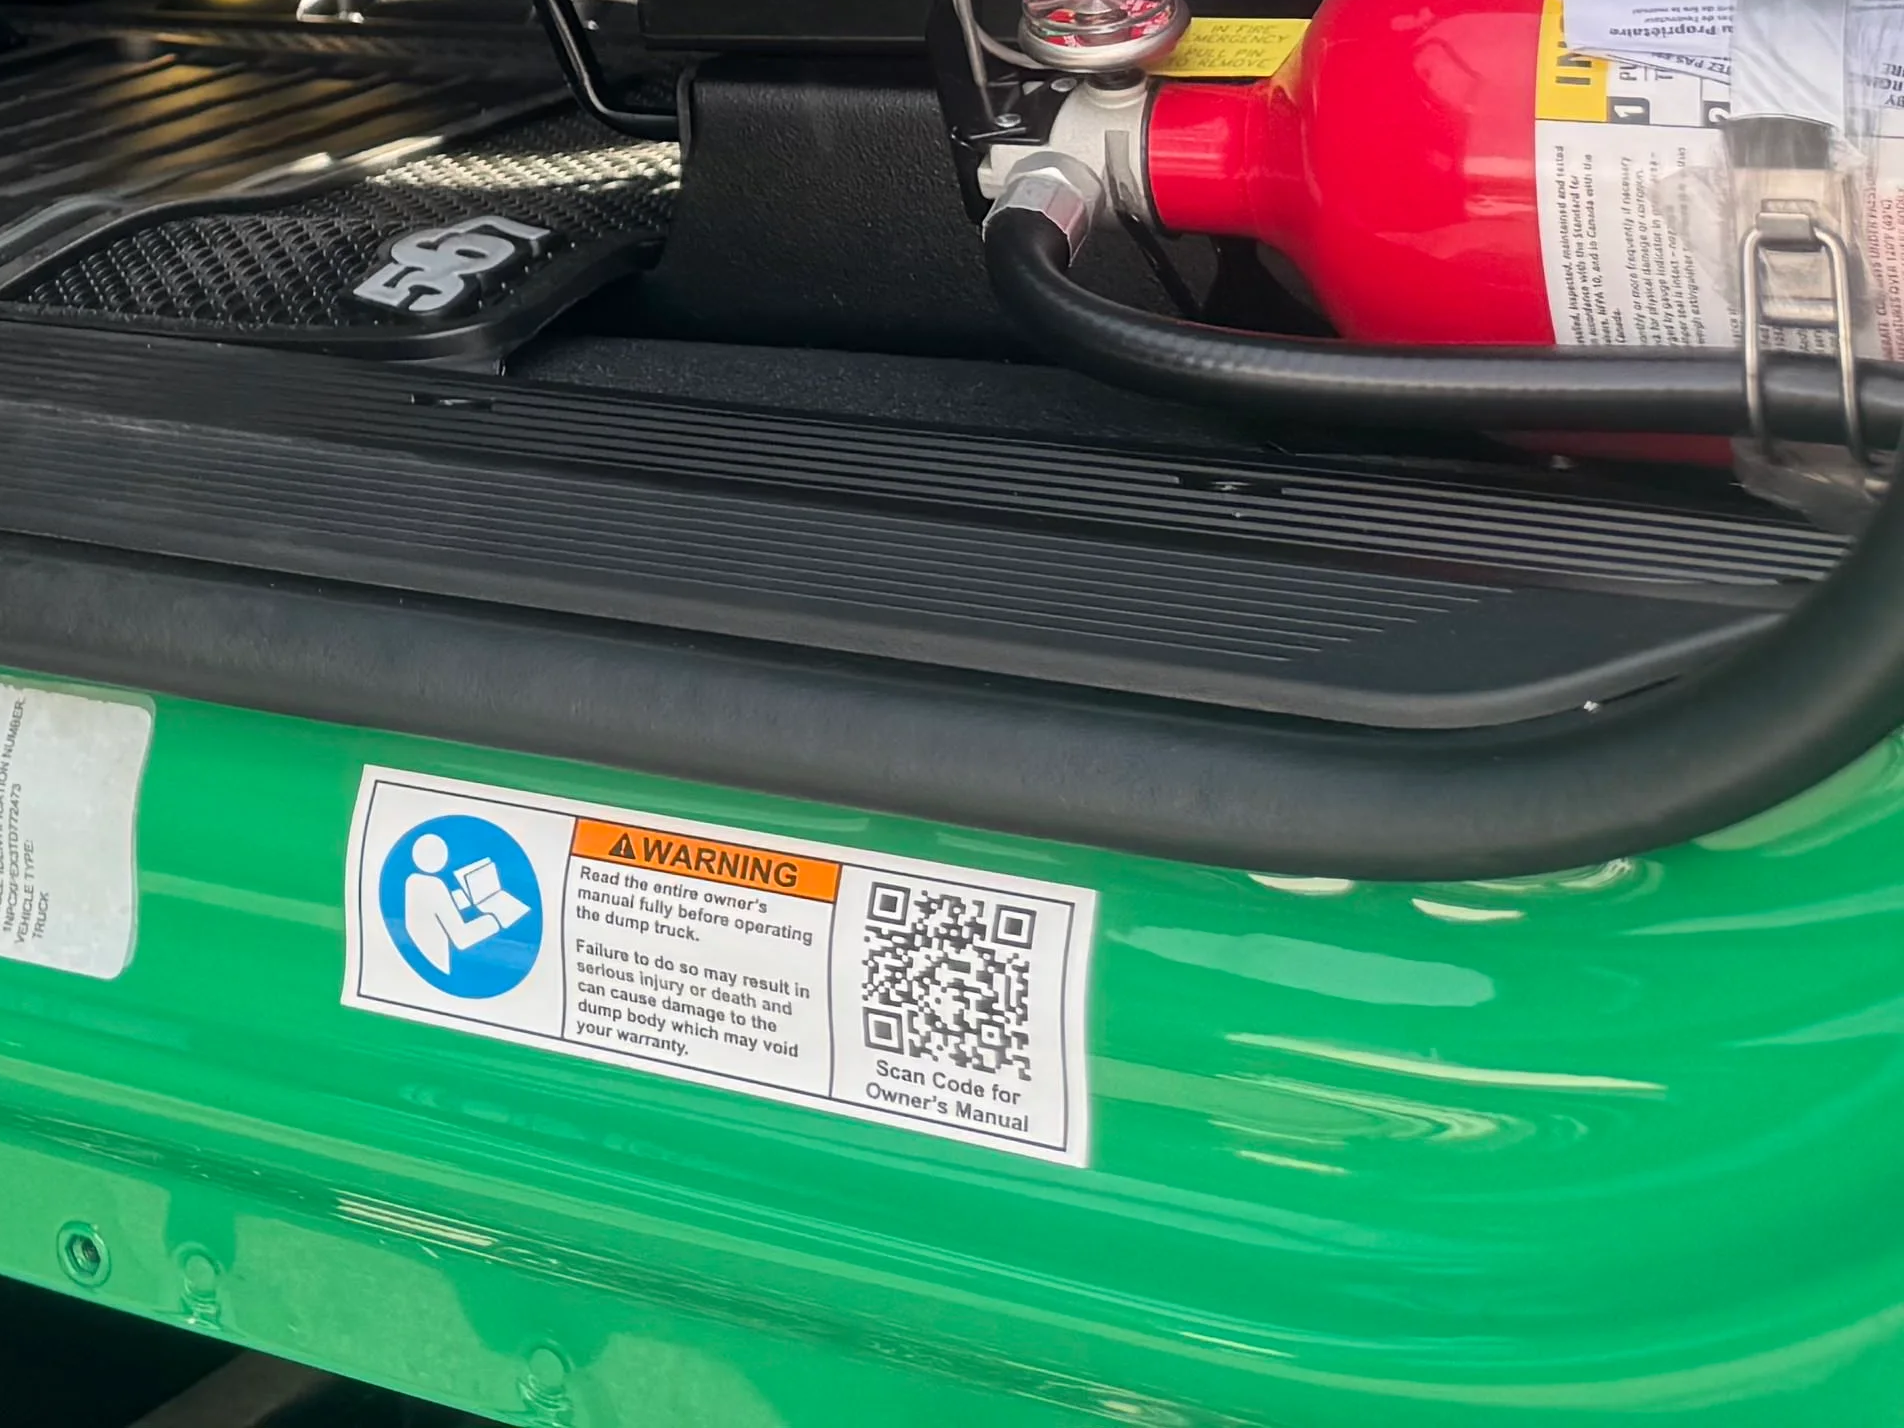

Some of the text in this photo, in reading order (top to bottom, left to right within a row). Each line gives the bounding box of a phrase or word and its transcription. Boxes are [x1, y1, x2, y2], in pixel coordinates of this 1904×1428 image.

[1609, 24, 1716, 38] Propriétaire
[353, 215, 551, 312] 567
[643, 837, 798, 887] WARNING
[15, 839, 34, 942] VEHICLE TYPE:
[31, 891, 48, 938] TRUCK
[580, 866, 767, 913] Read the entire owner's
[576, 906, 700, 941] the dump truck.
[578, 887, 812, 946] manual fully before operating
[576, 939, 809, 999] Failure to do so may result in
[577, 961, 792, 1015] serious injury or death and
[578, 981, 777, 1032] can cause damage to the
[578, 999, 798, 1057] dump body which may void
[576, 1019, 688, 1056] your warranty.
[866, 1082, 1029, 1132] Owner's Manual
[876, 1059, 1021, 1105] Scan Code for
